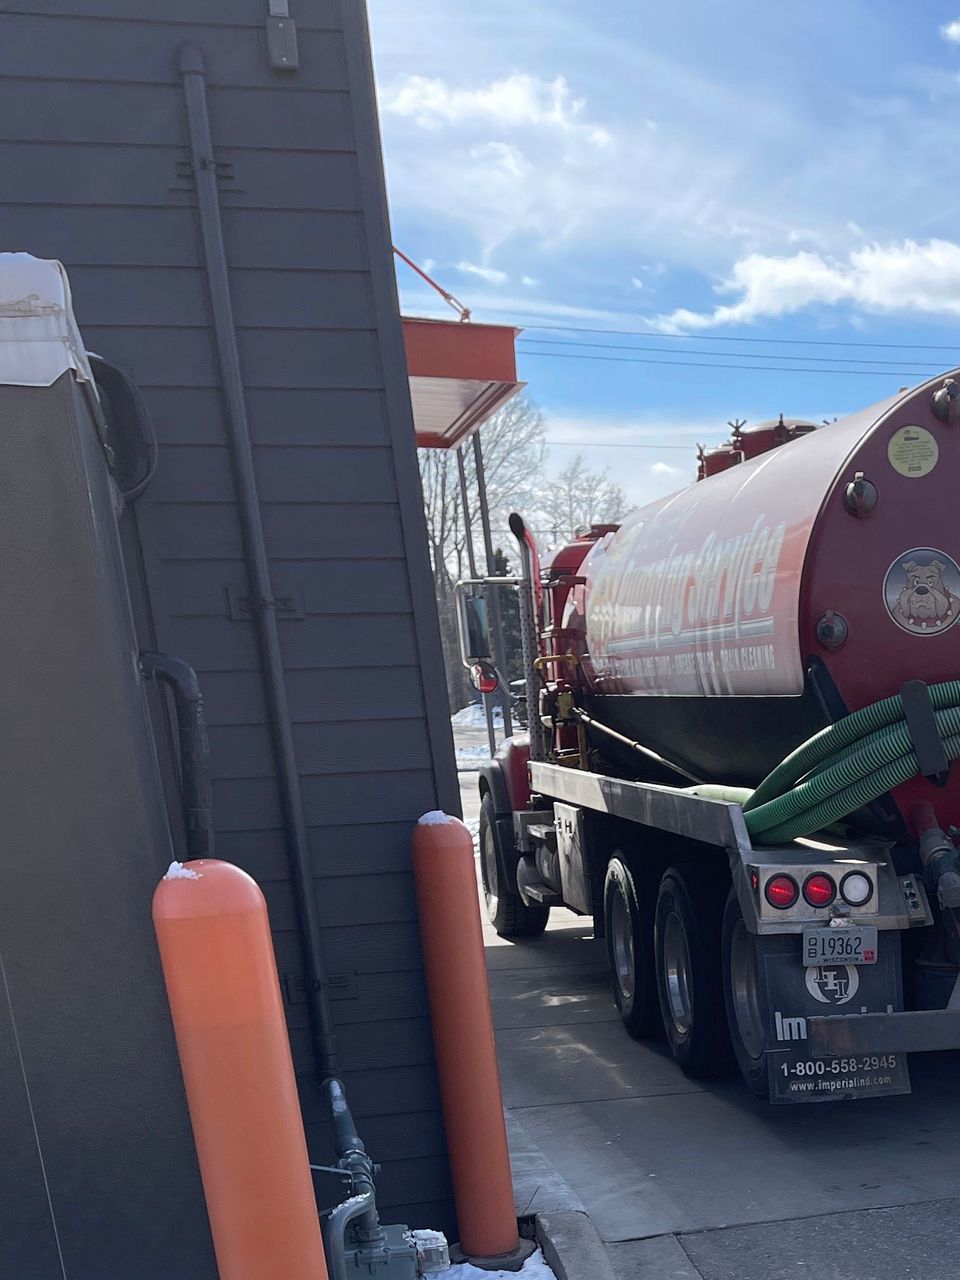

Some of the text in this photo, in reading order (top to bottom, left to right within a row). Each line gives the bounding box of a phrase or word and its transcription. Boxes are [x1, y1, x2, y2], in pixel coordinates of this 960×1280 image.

[741, 644, 775, 671] CLEANING
[820, 936, 862, 956] 19362
[781, 1056, 896, 1077] 1-800-558-2945
[790, 1075, 891, 1092] www.imperialind.com
